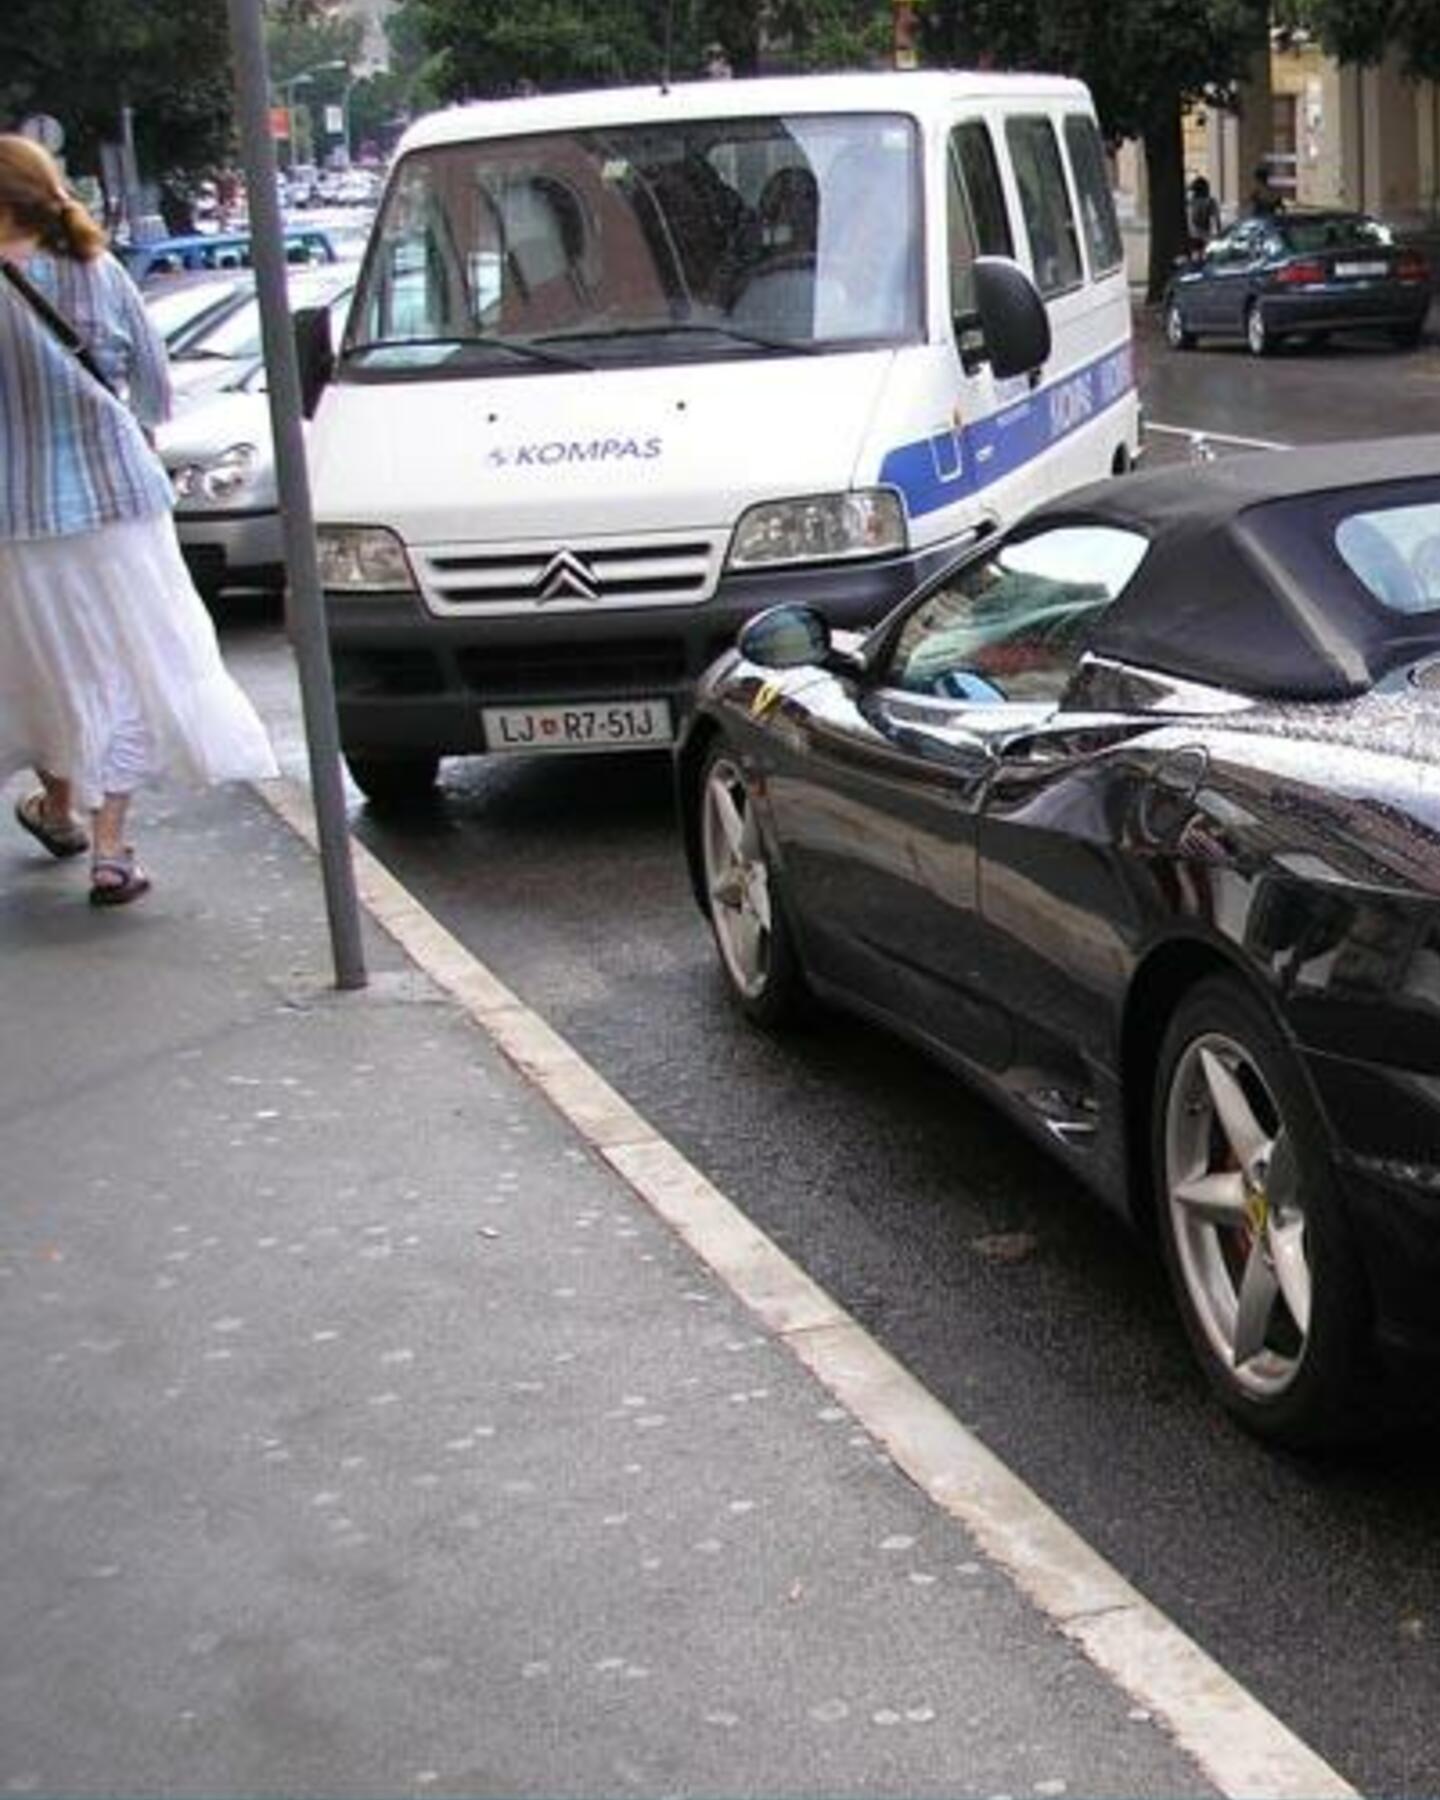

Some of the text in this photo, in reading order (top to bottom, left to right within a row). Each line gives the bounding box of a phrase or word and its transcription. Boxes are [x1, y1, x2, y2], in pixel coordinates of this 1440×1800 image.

[516, 437, 662, 466] KOMPAS
[500, 708, 653, 742] LJ R7-51J
